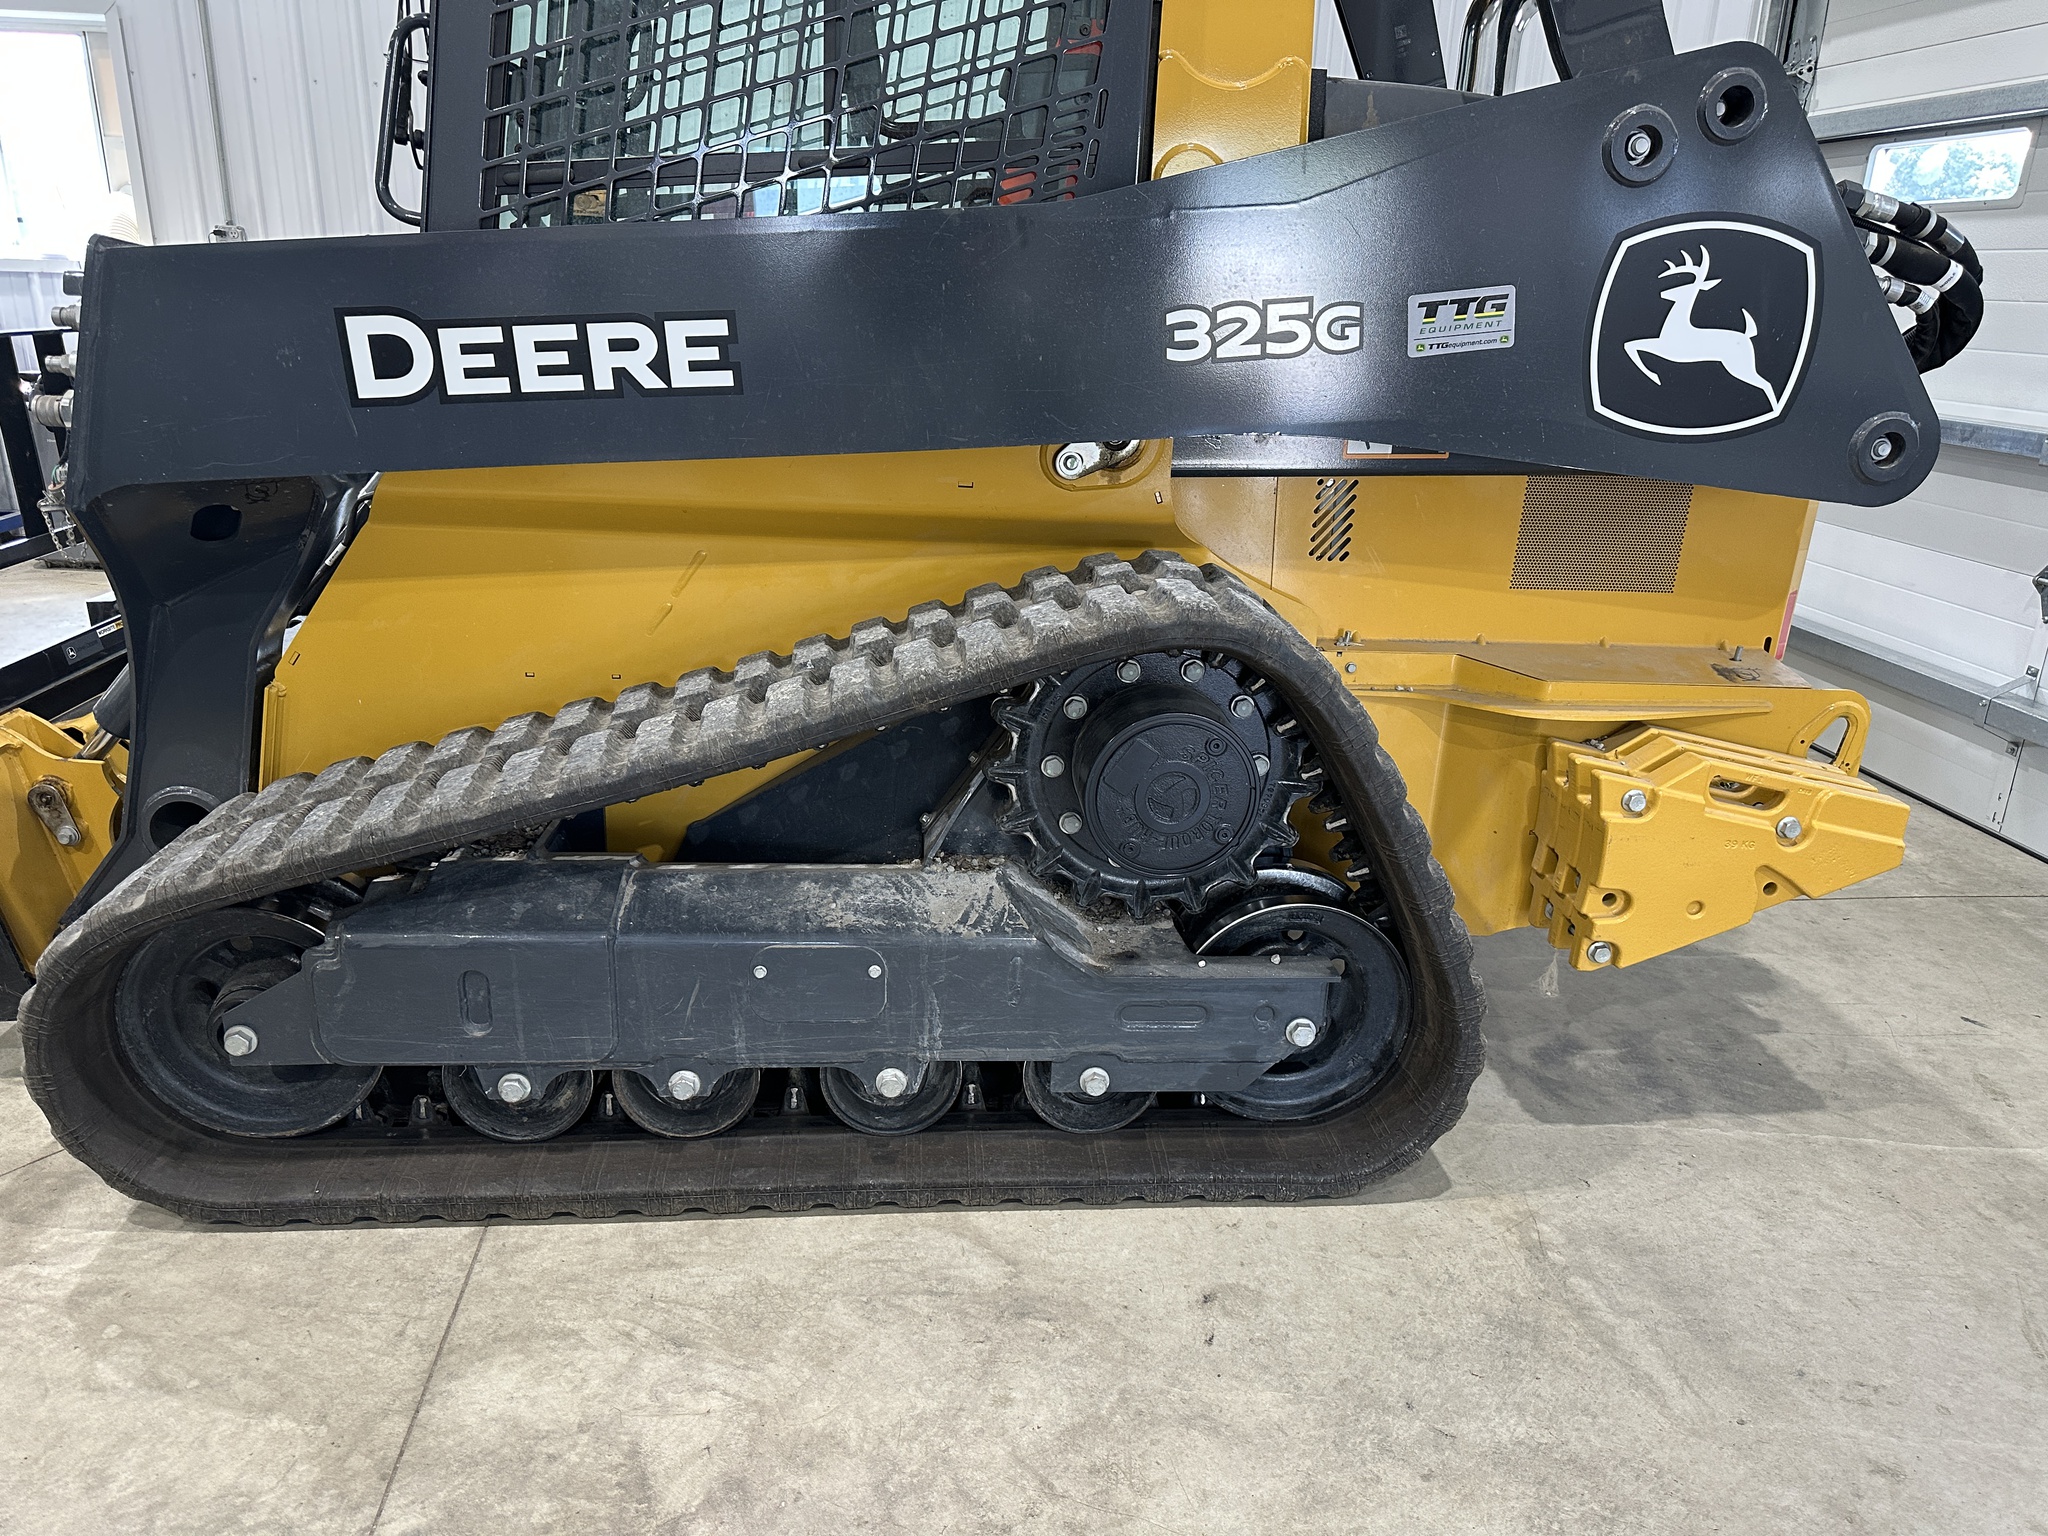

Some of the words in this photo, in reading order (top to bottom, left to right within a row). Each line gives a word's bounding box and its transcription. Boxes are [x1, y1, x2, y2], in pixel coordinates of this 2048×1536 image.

[1417, 293, 1510, 325] TTG
[1165, 300, 1362, 362] 325G
[1419, 320, 1503, 335] EQUIPMENT
[344, 314, 735, 400] DEERE
[1428, 338, 1498, 351] TTGequipment.com
[1180, 745, 1229, 811] SPICER
[1724, 839, 1739, 850] 39
[1741, 839, 1756, 851] KG
